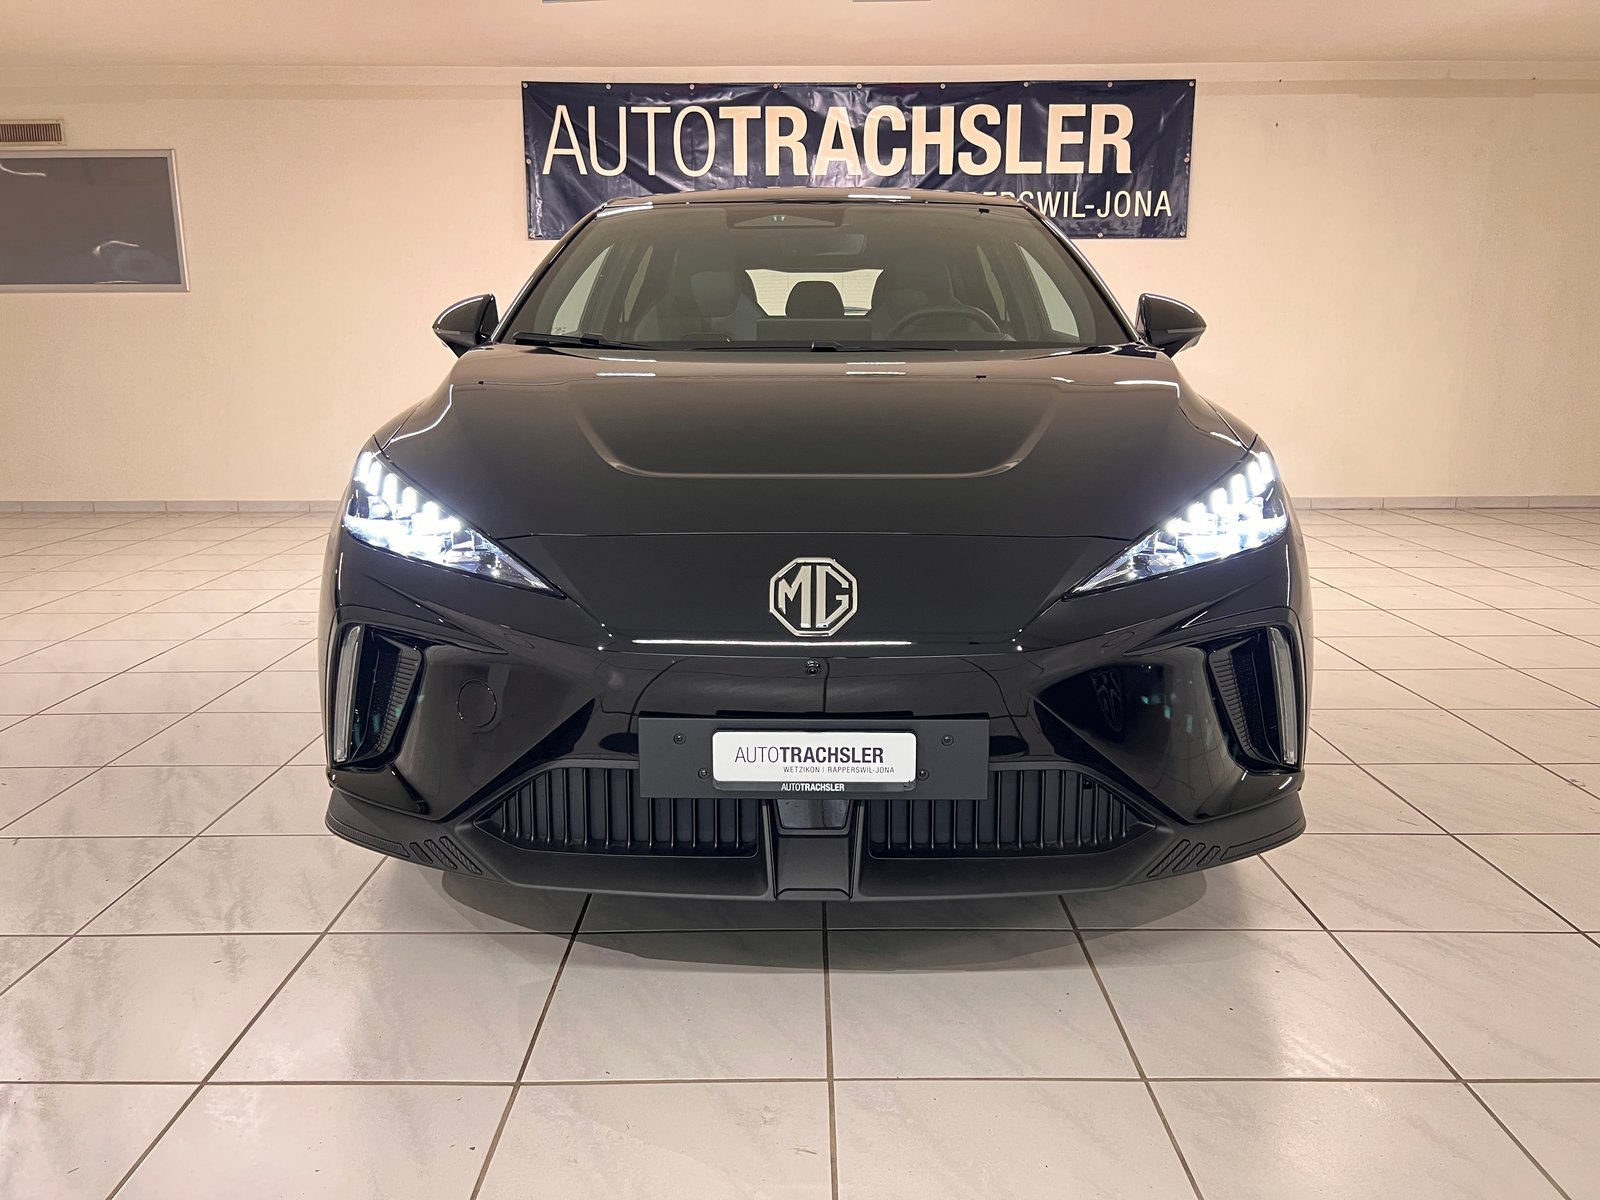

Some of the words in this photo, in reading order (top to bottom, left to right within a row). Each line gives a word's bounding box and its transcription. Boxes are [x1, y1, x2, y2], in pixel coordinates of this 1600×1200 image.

[778, 564, 850, 629] MG
[783, 766, 820, 774] WETZIKON
[827, 766, 895, 774] RAPPERSWIL-JONA
[780, 782, 845, 792] AUTOTRACHSLER
